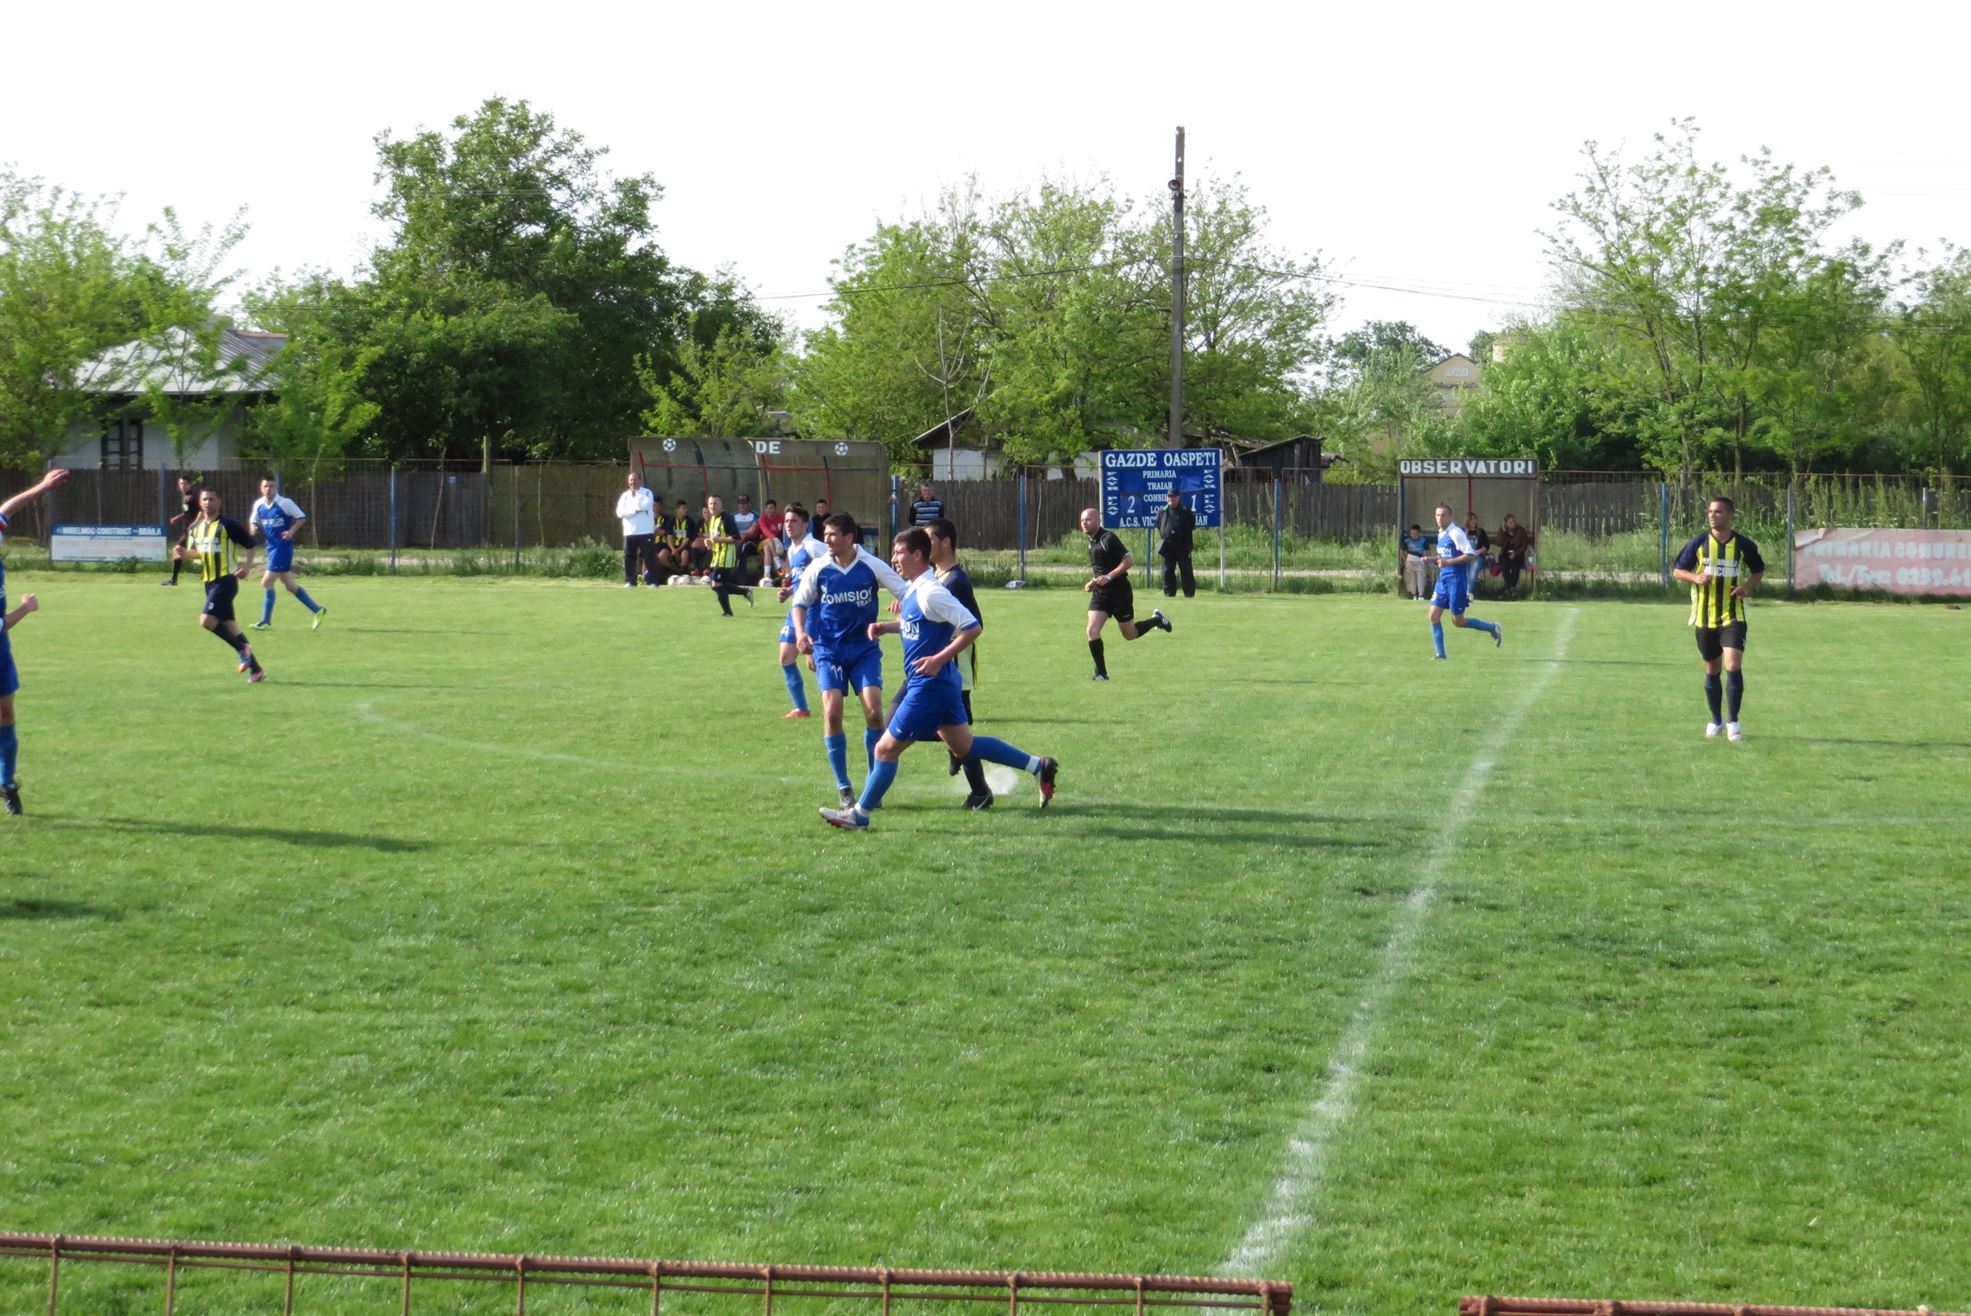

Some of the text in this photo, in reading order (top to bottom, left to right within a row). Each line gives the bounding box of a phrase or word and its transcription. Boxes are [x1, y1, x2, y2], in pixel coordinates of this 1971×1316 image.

[755, 441, 781, 454] DE
[1105, 452, 1216, 467] GAZDE OASPETI
[1400, 460, 1533, 474] OBSERVATORI
[1142, 470, 1177, 479] PRIMARIA
[1147, 482, 1173, 490] TRAIAN
[1127, 496, 1135, 514] 2
[1191, 494, 1197, 512] 1
[1120, 517, 1140, 528] A.C.S.
